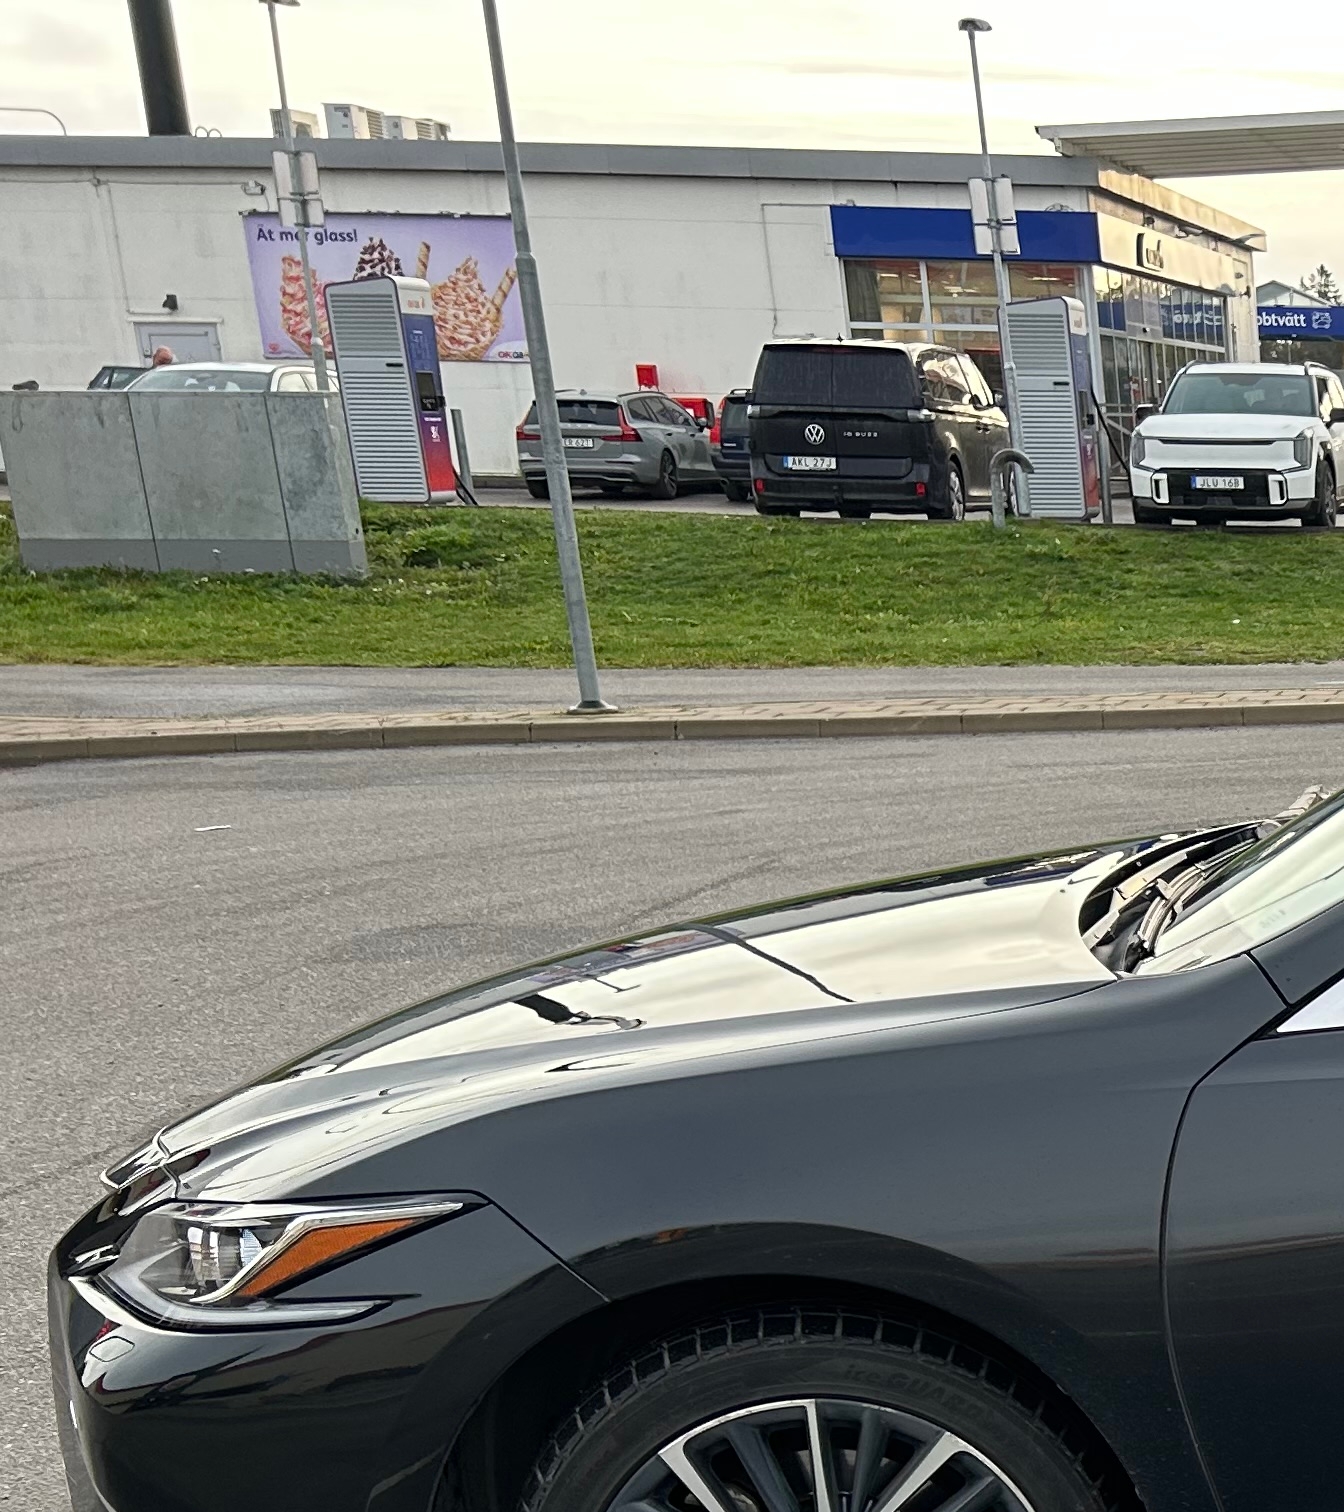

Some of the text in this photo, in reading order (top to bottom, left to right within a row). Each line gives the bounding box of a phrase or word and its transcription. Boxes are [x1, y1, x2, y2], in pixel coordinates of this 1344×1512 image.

[256, 223, 275, 241] Åt
[314, 228, 358, 246] glass!
[792, 457, 809, 467] AKL
[1200, 478, 1219, 487] JLU
